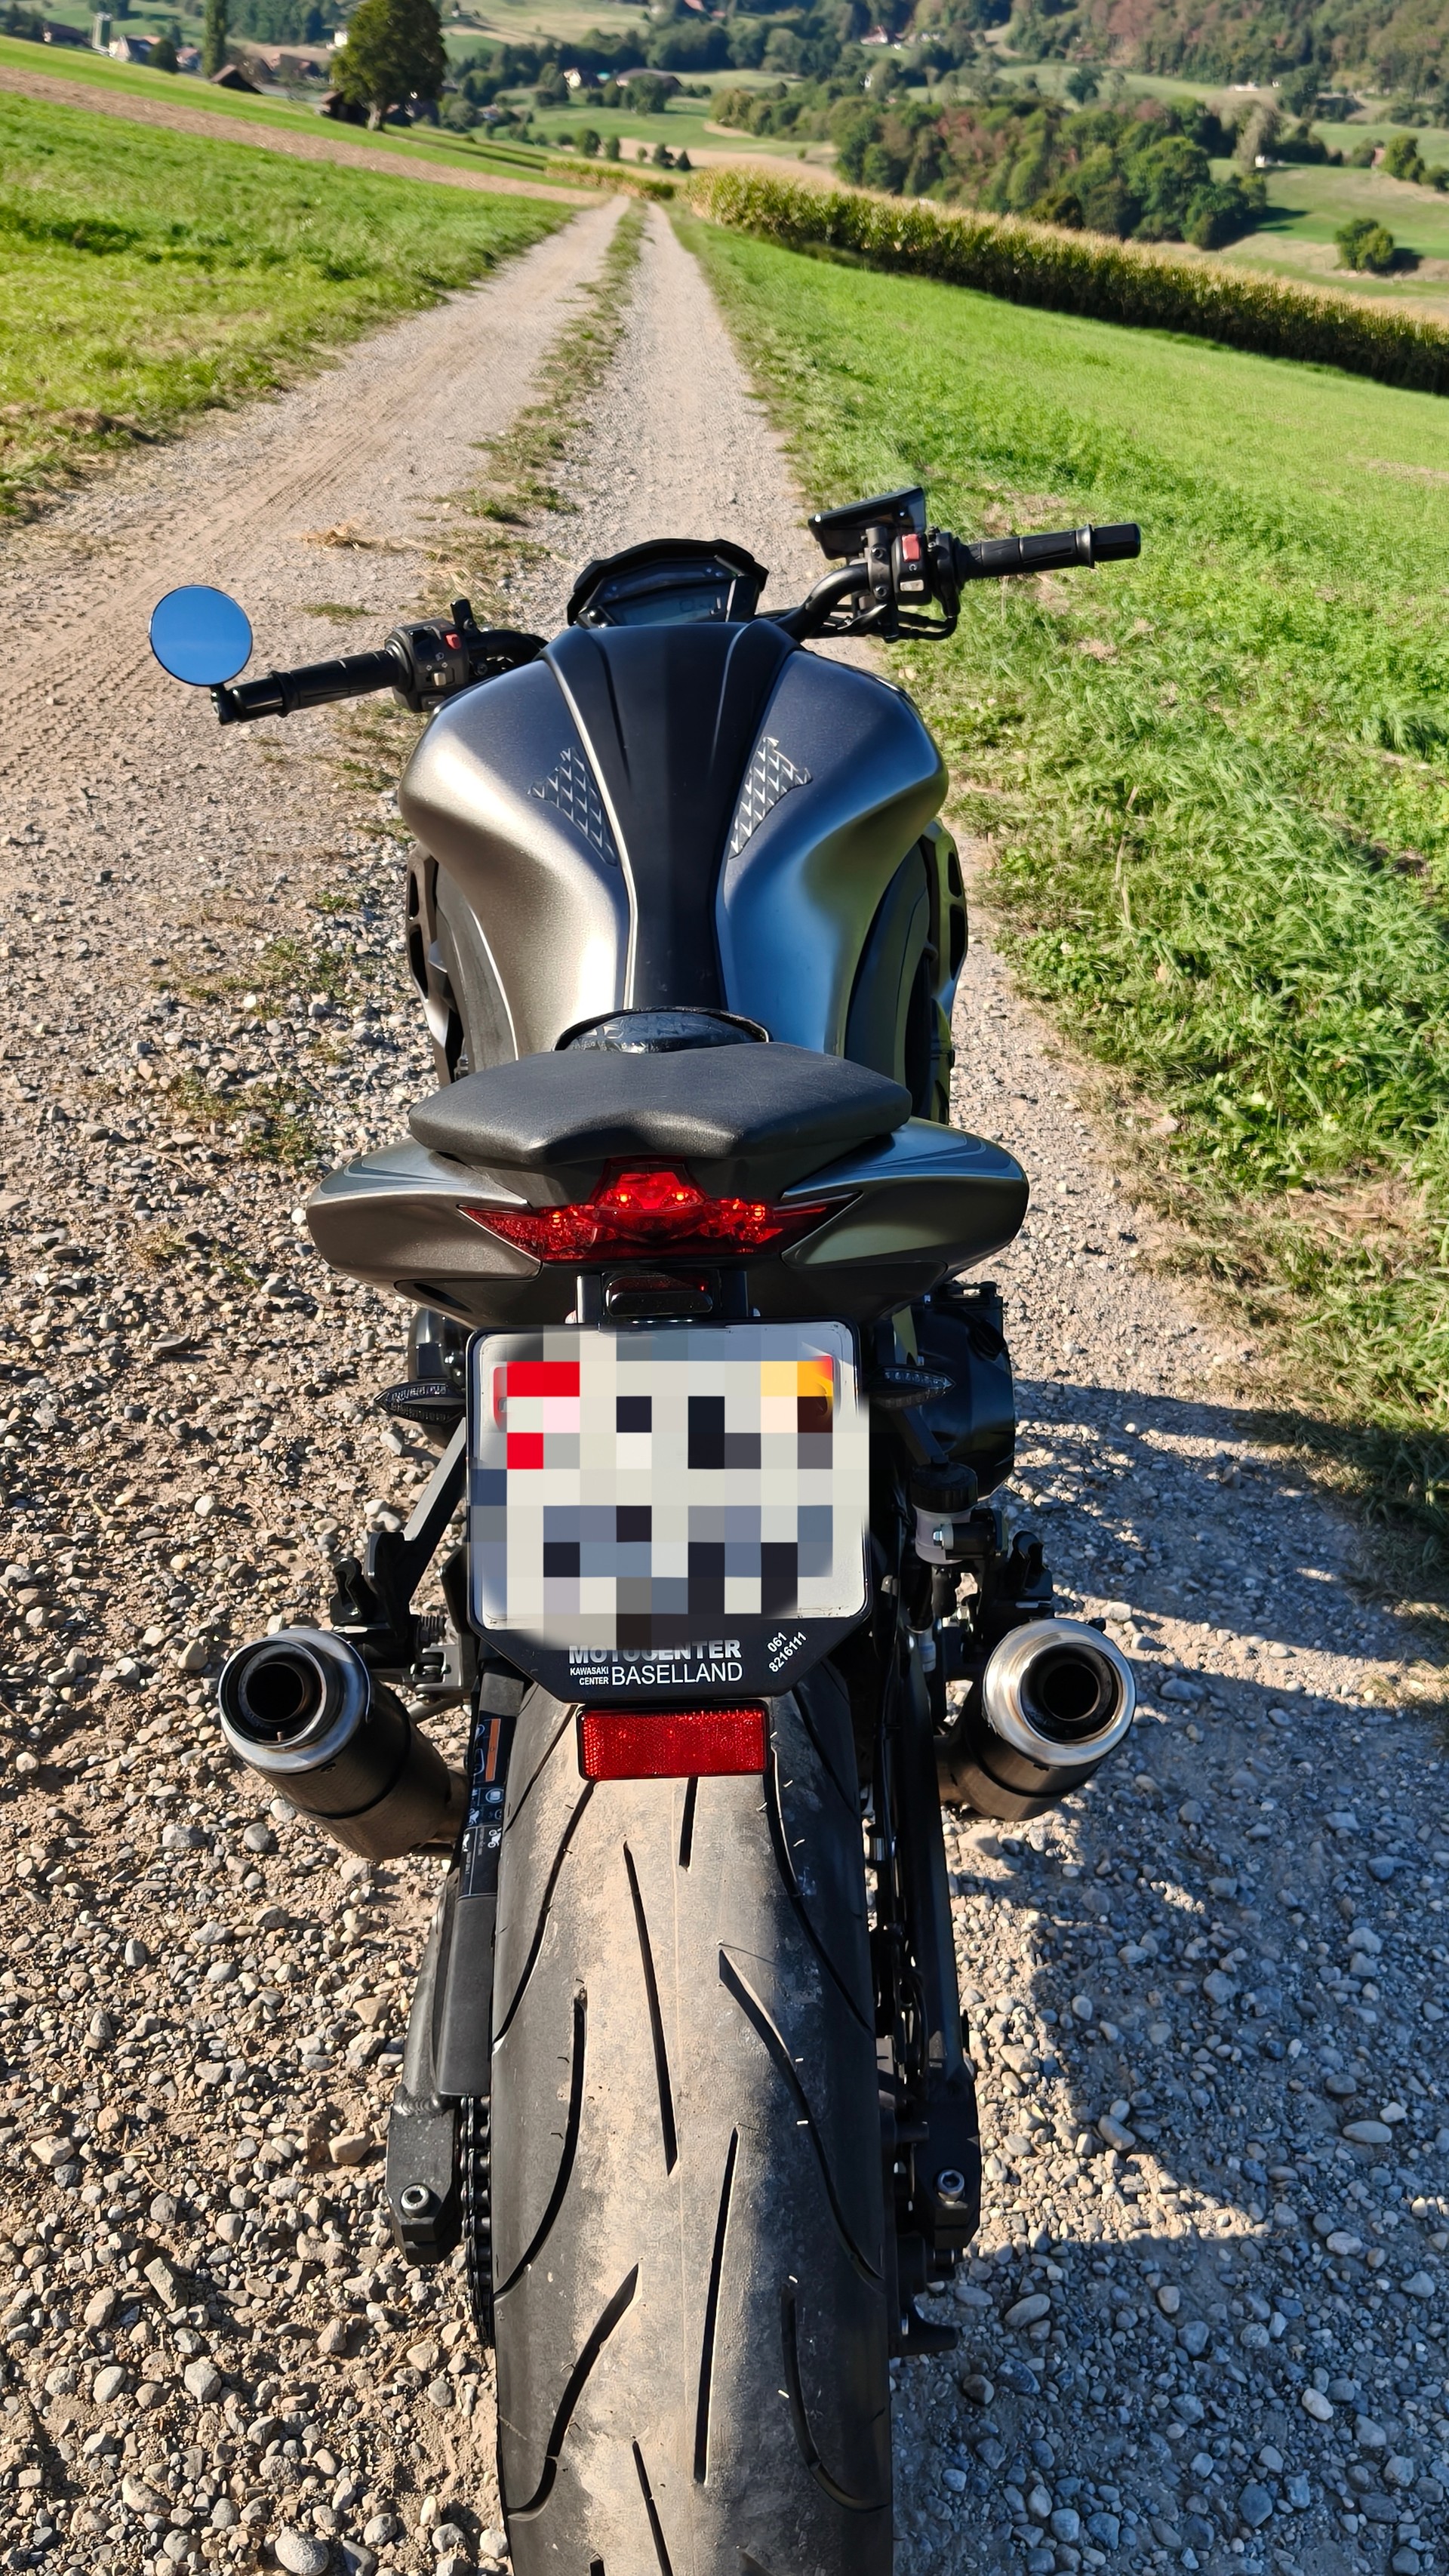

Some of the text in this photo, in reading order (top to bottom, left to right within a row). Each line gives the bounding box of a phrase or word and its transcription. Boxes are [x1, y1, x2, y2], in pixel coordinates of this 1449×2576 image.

[569, 1640, 742, 1663] MOTOCENTER
[768, 1632, 787, 1652] 061
[769, 1632, 807, 1673] 8216111
[570, 1666, 609, 1676] KAWASAKI
[579, 1676, 609, 1685] CENTER
[611, 1662, 743, 1685] BASELLAND
